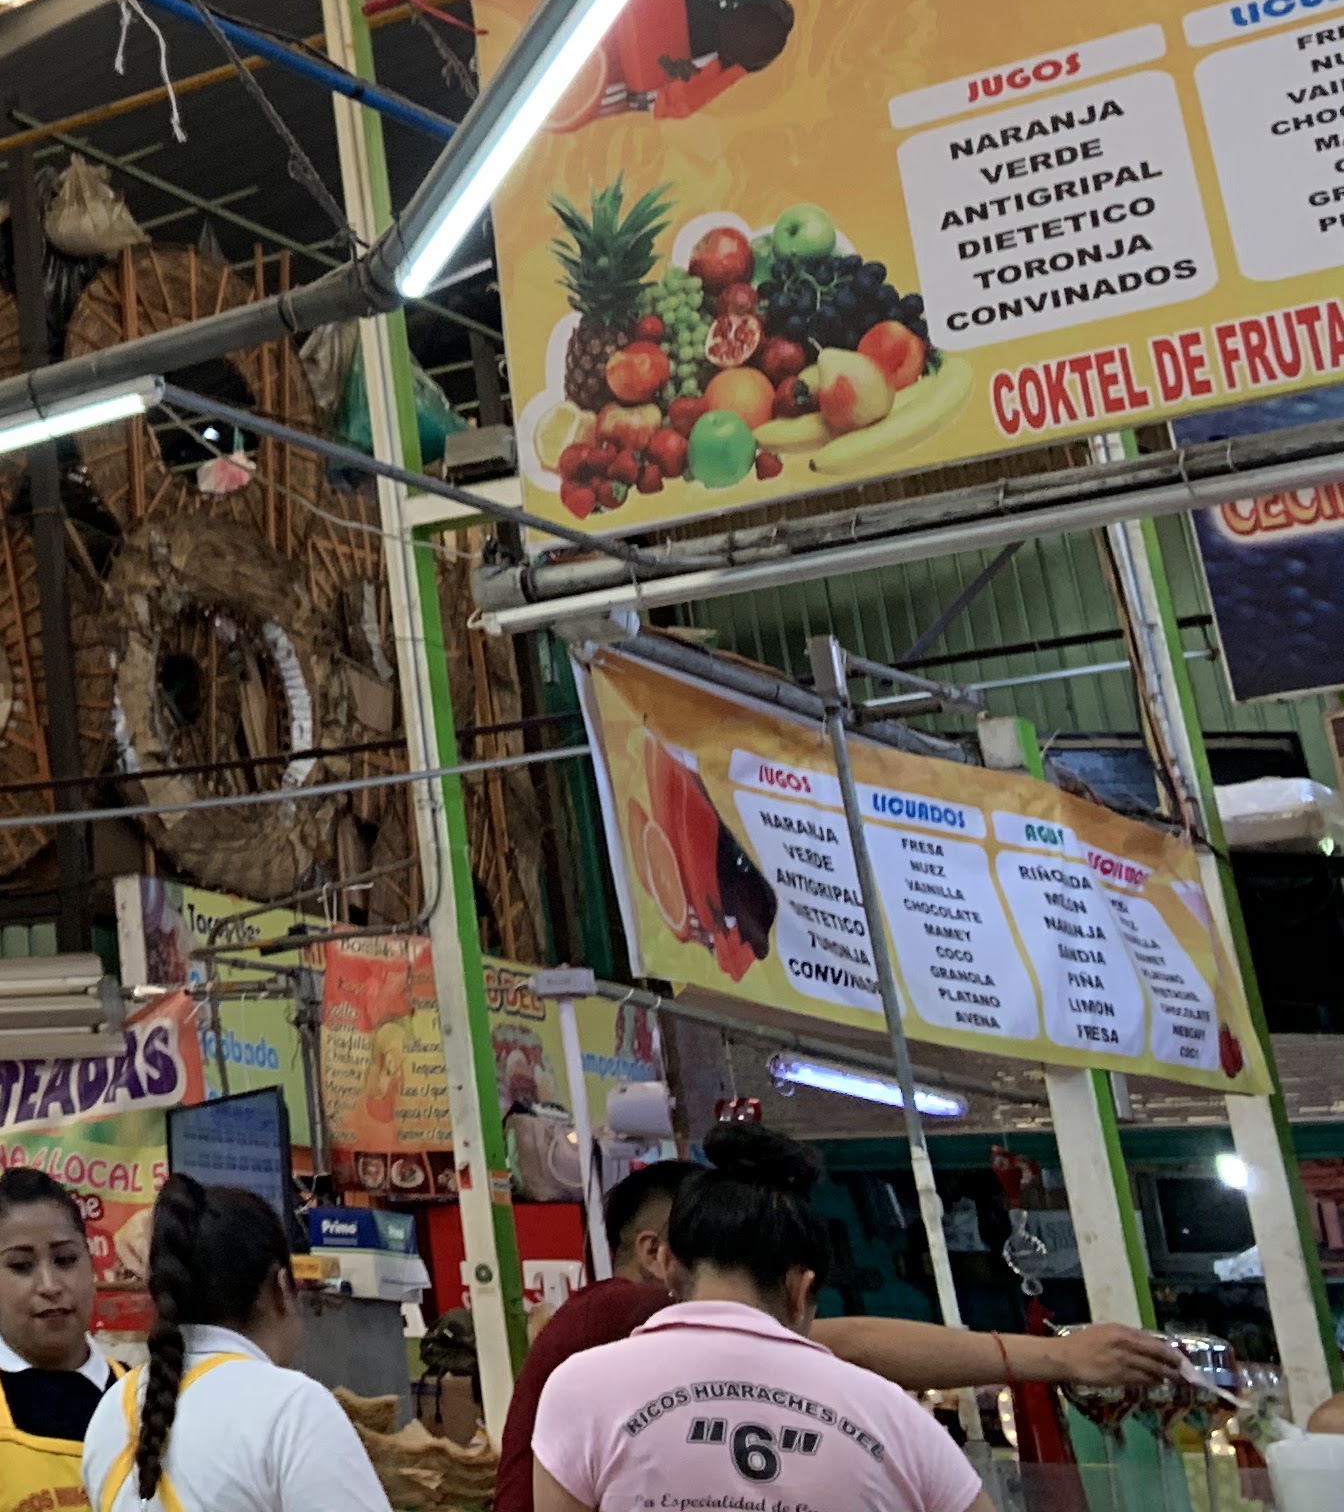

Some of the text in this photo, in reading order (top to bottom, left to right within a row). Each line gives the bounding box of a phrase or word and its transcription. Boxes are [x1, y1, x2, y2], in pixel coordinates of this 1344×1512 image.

[967, 52, 1082, 104] JUGOS
[948, 98, 1125, 161] NARANJA
[979, 138, 1104, 185] VERDE
[939, 160, 1164, 232] ANTIGRIPAL
[956, 196, 1156, 261] DIETETICO
[972, 233, 1154, 291] TORONJA
[945, 258, 1199, 333] CONVINADOS
[993, 346, 1150, 437] COKTEL
[1151, 331, 1213, 403] DE
[759, 810, 839, 845] NARANJA
[871, 792, 966, 829] LICUADOS
[782, 841, 835, 872] VERDE
[901, 837, 945, 858] FRESA
[909, 859, 947, 878] NUEZ
[776, 868, 864, 908] ANTIGRIPAL
[904, 877, 966, 901] VAINILLA
[902, 898, 983, 925] CHOCOLATE
[923, 922, 973, 942] MAMEY
[935, 945, 975, 964] COCO
[929, 964, 996, 988] GRANOLA
[938, 987, 1002, 1009] PLATANO
[1068, 997, 1115, 1018] LIMON
[954, 1009, 1001, 1030] AVENA
[46, 1149, 144, 1192] LOCAL
[621, 1380, 889, 1464] RICOS HUARACHES DEL
